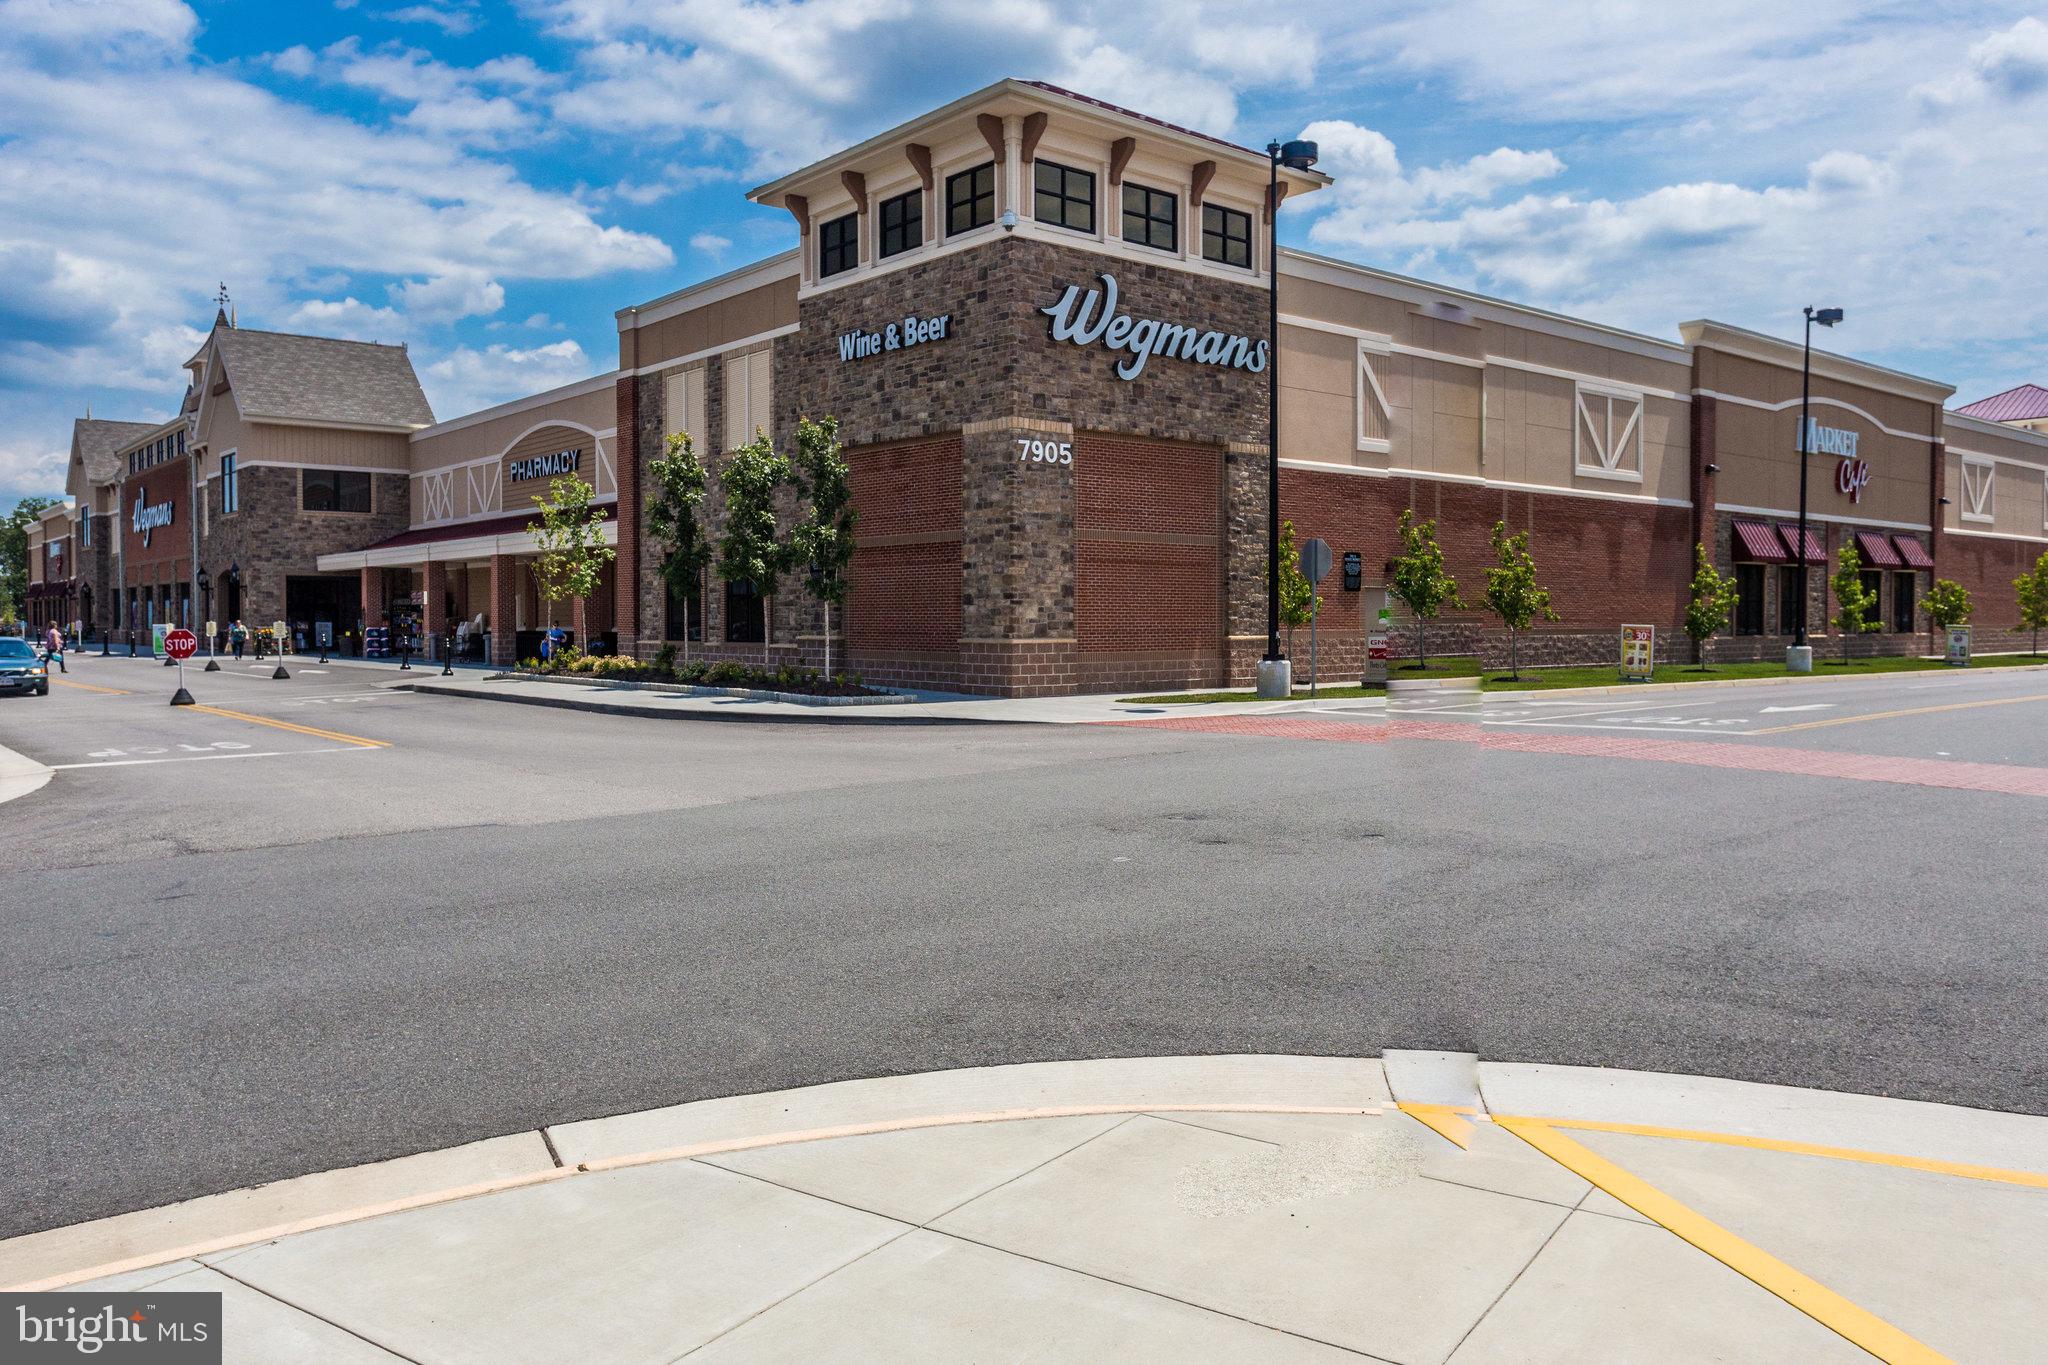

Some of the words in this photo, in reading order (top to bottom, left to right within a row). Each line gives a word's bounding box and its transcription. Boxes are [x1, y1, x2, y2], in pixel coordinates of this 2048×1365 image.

[839, 329, 881, 362] Wine
[884, 323, 901, 351] &
[904, 314, 949, 347] Beer
[1041, 273, 1268, 381] Wegmans
[1018, 439, 1072, 465] 7905
[1795, 415, 1859, 458] MARKET
[510, 449, 579, 482] PHARMACY
[131, 486, 173, 549] Wegmans
[166, 638, 196, 651] STOP
